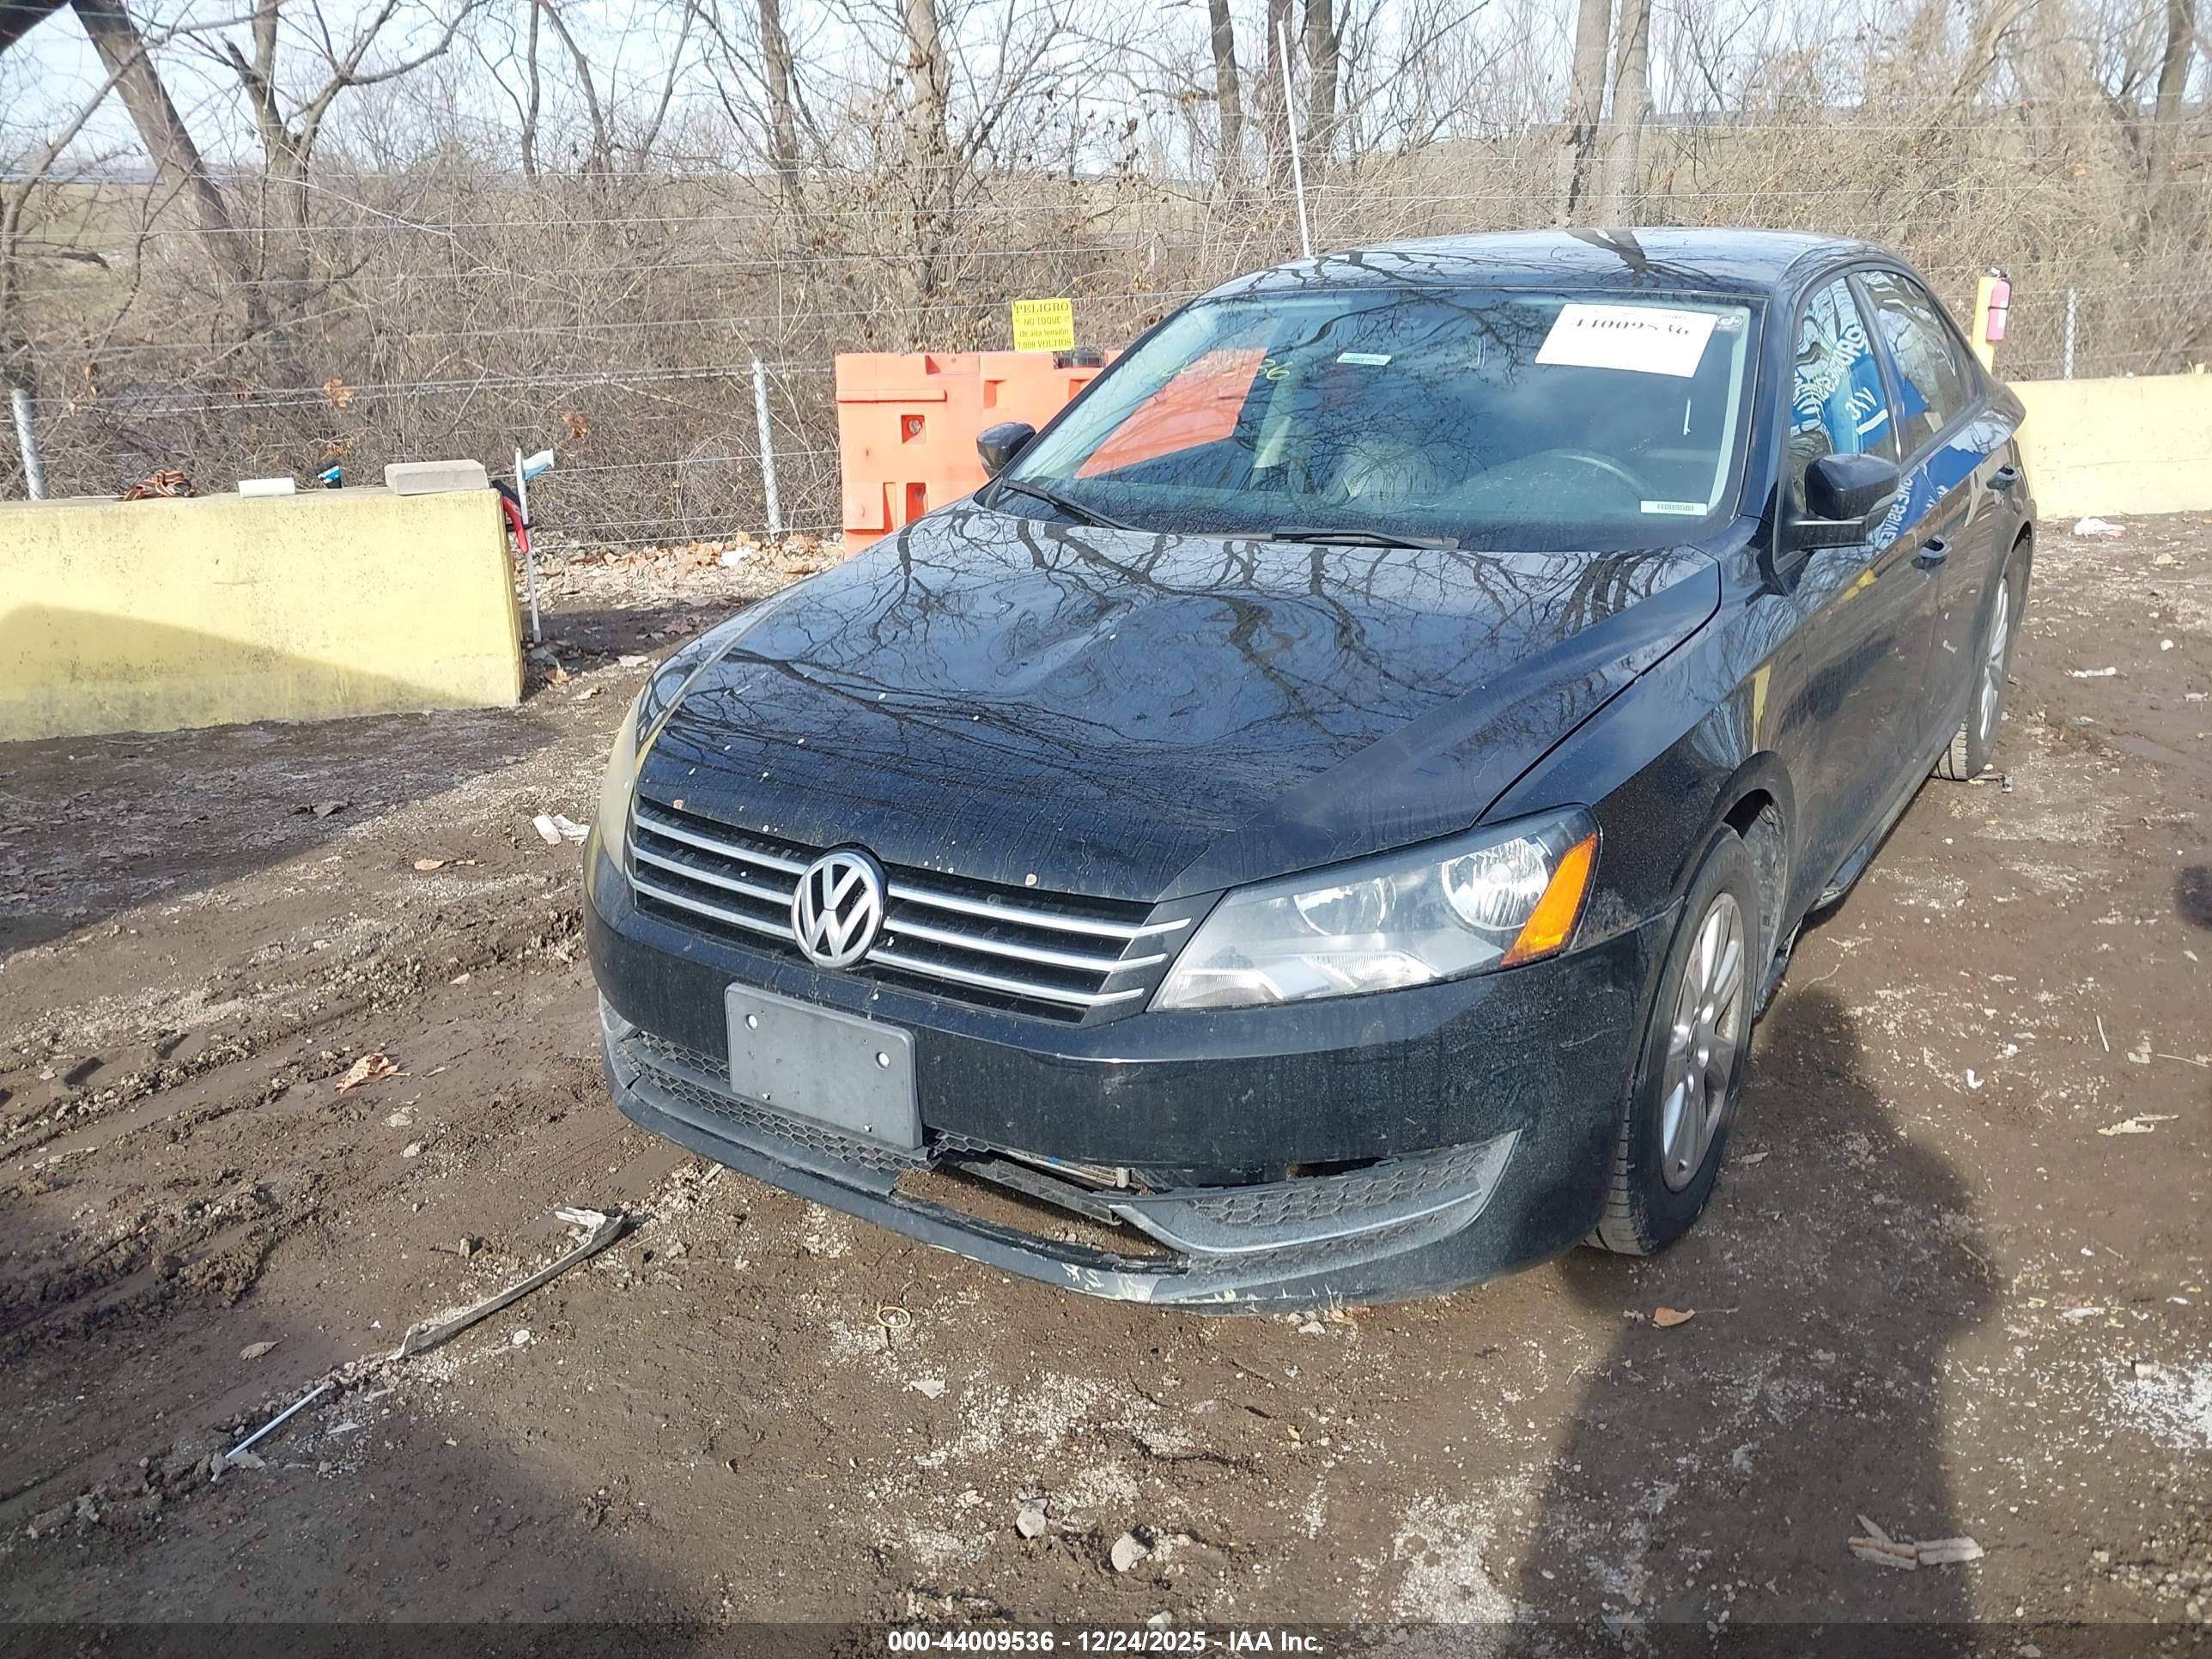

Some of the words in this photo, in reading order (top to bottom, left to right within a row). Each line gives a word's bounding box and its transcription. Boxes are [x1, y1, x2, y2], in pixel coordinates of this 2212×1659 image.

[1015, 301, 1069, 313] PELIGRO
[1024, 317, 1035, 325] NO
[1037, 315, 1061, 325] TOQUE
[1037, 337, 1072, 348] VOLTIOS
